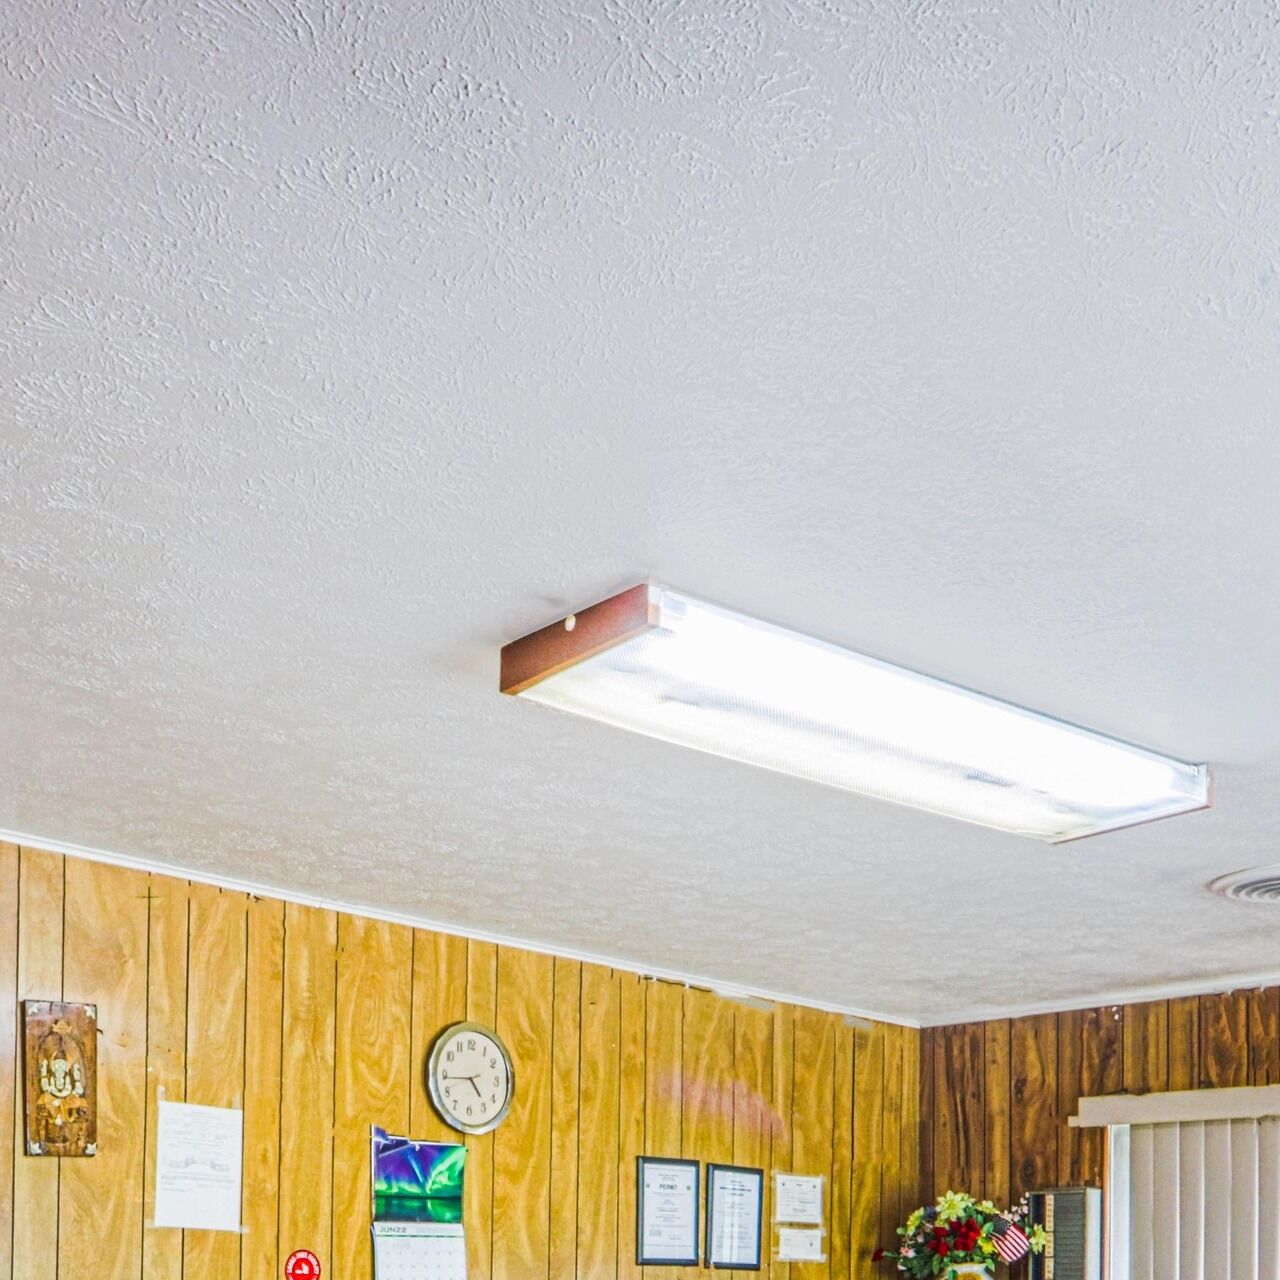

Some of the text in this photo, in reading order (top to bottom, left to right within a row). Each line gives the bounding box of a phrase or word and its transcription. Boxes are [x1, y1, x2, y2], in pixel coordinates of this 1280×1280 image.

[456, 1041, 463, 1053] 11
[467, 1040, 476, 1051] 12
[446, 1051, 454, 1062] 10
[482, 1046, 487, 1057] 1
[490, 1058, 496, 1069] 2
[493, 1076, 499, 1087] 3
[445, 1086, 450, 1097] 8
[490, 1094, 496, 1104] 4
[453, 1100, 458, 1110] 7
[466, 1105, 472, 1116] 6
